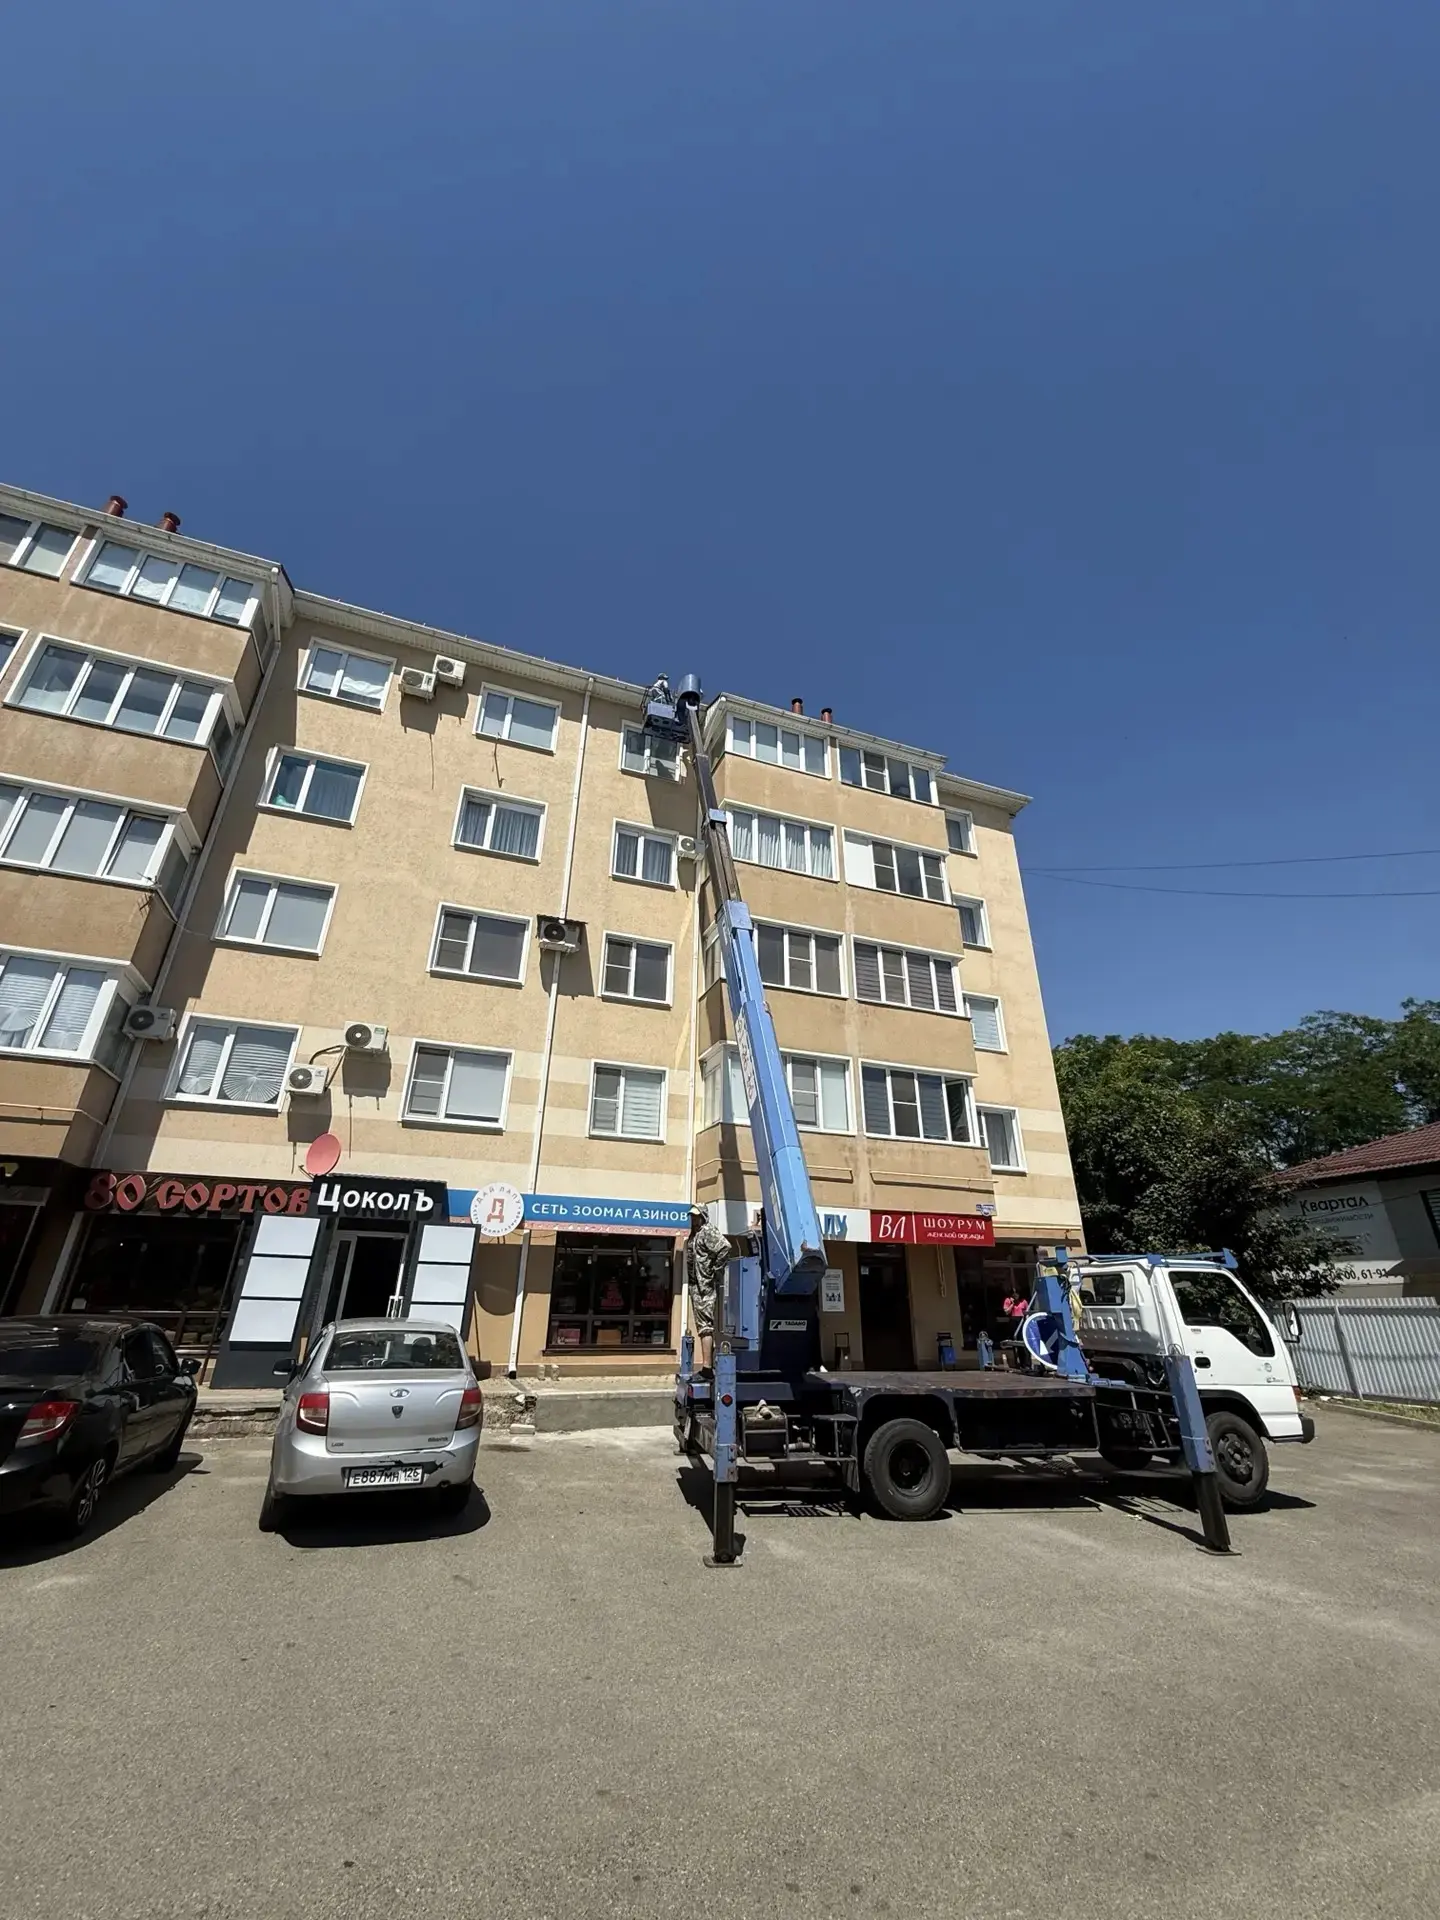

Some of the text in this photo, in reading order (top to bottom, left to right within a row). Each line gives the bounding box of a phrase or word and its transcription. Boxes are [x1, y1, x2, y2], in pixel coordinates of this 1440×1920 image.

[84, 1172, 312, 1215] 80 СОРТОВ
[476, 1186, 521, 1205] ДАЙ ЛАПУ
[531, 1203, 688, 1222] СЕТЬ ЗООМАГАЗИНОВ
[1299, 1196, 1370, 1216] Квартал
[879, 1214, 906, 1239] ВЛ
[923, 1217, 986, 1231] ШОУРУМ
[403, 1467, 420, 1478] 126
